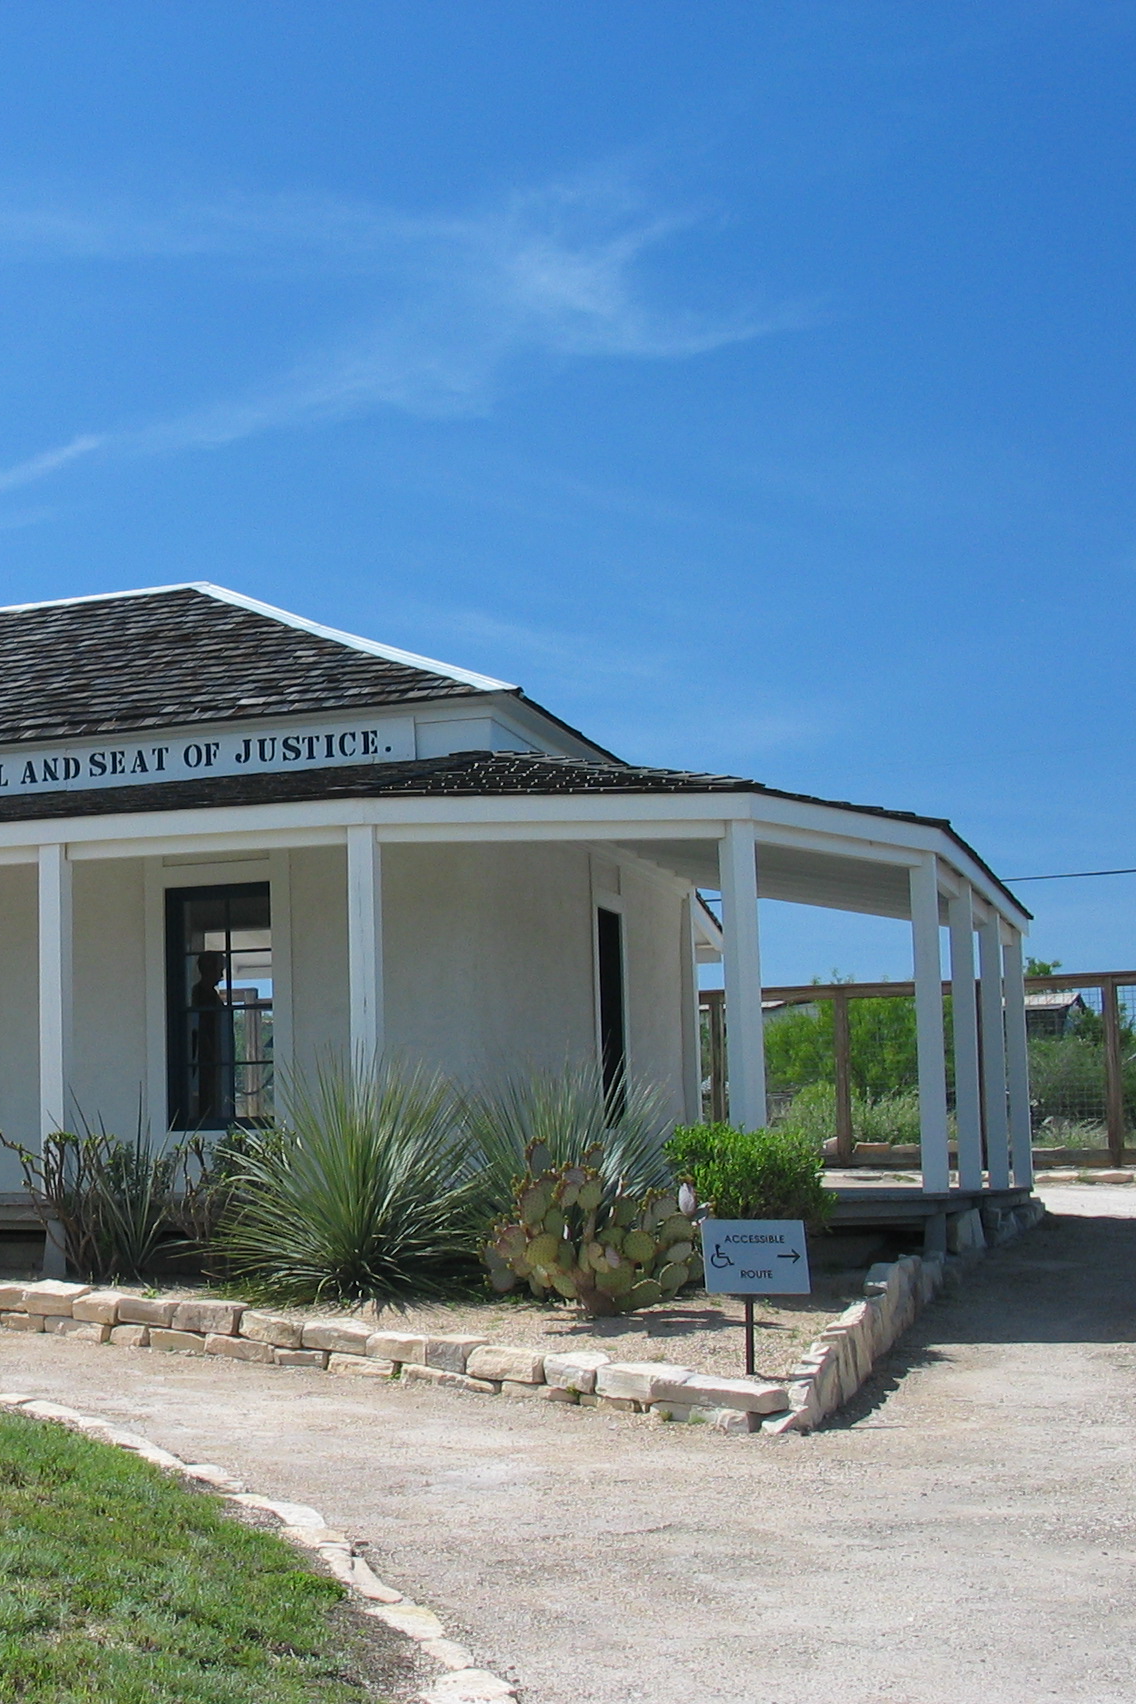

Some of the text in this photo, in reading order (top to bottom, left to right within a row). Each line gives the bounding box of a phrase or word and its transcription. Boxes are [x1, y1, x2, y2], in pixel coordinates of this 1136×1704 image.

[21, 757, 80, 785] AND
[88, 747, 169, 777] SEAT
[183, 742, 220, 768] OF
[235, 729, 392, 763] JUSTICE.
[724, 1234, 785, 1243] ACCESSIBLE
[740, 1270, 773, 1279] ROUTE
